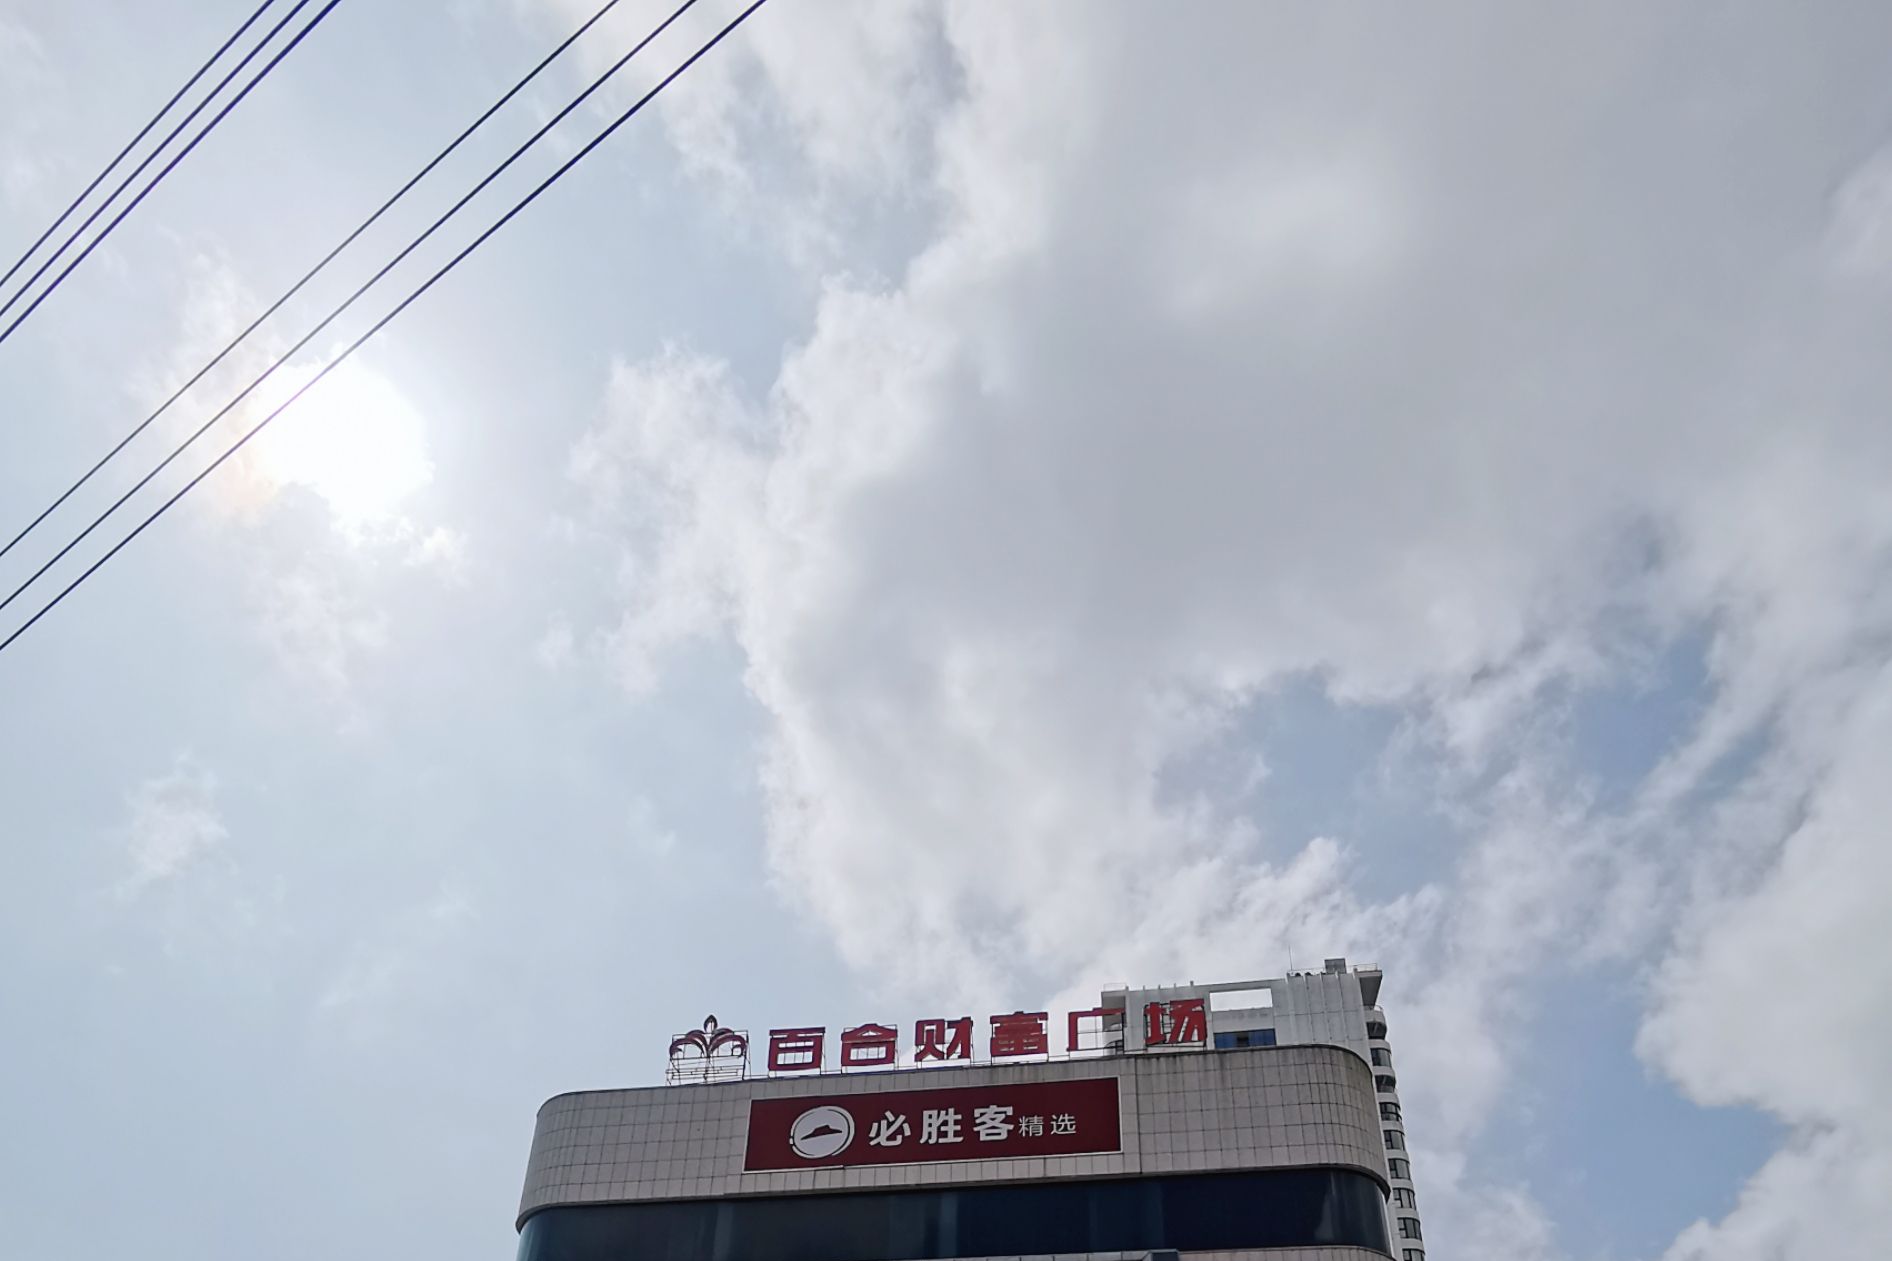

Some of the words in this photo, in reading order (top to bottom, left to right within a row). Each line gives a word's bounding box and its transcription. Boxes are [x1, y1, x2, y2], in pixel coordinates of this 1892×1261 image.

[768, 998, 1208, 1071] 百合财富广场
